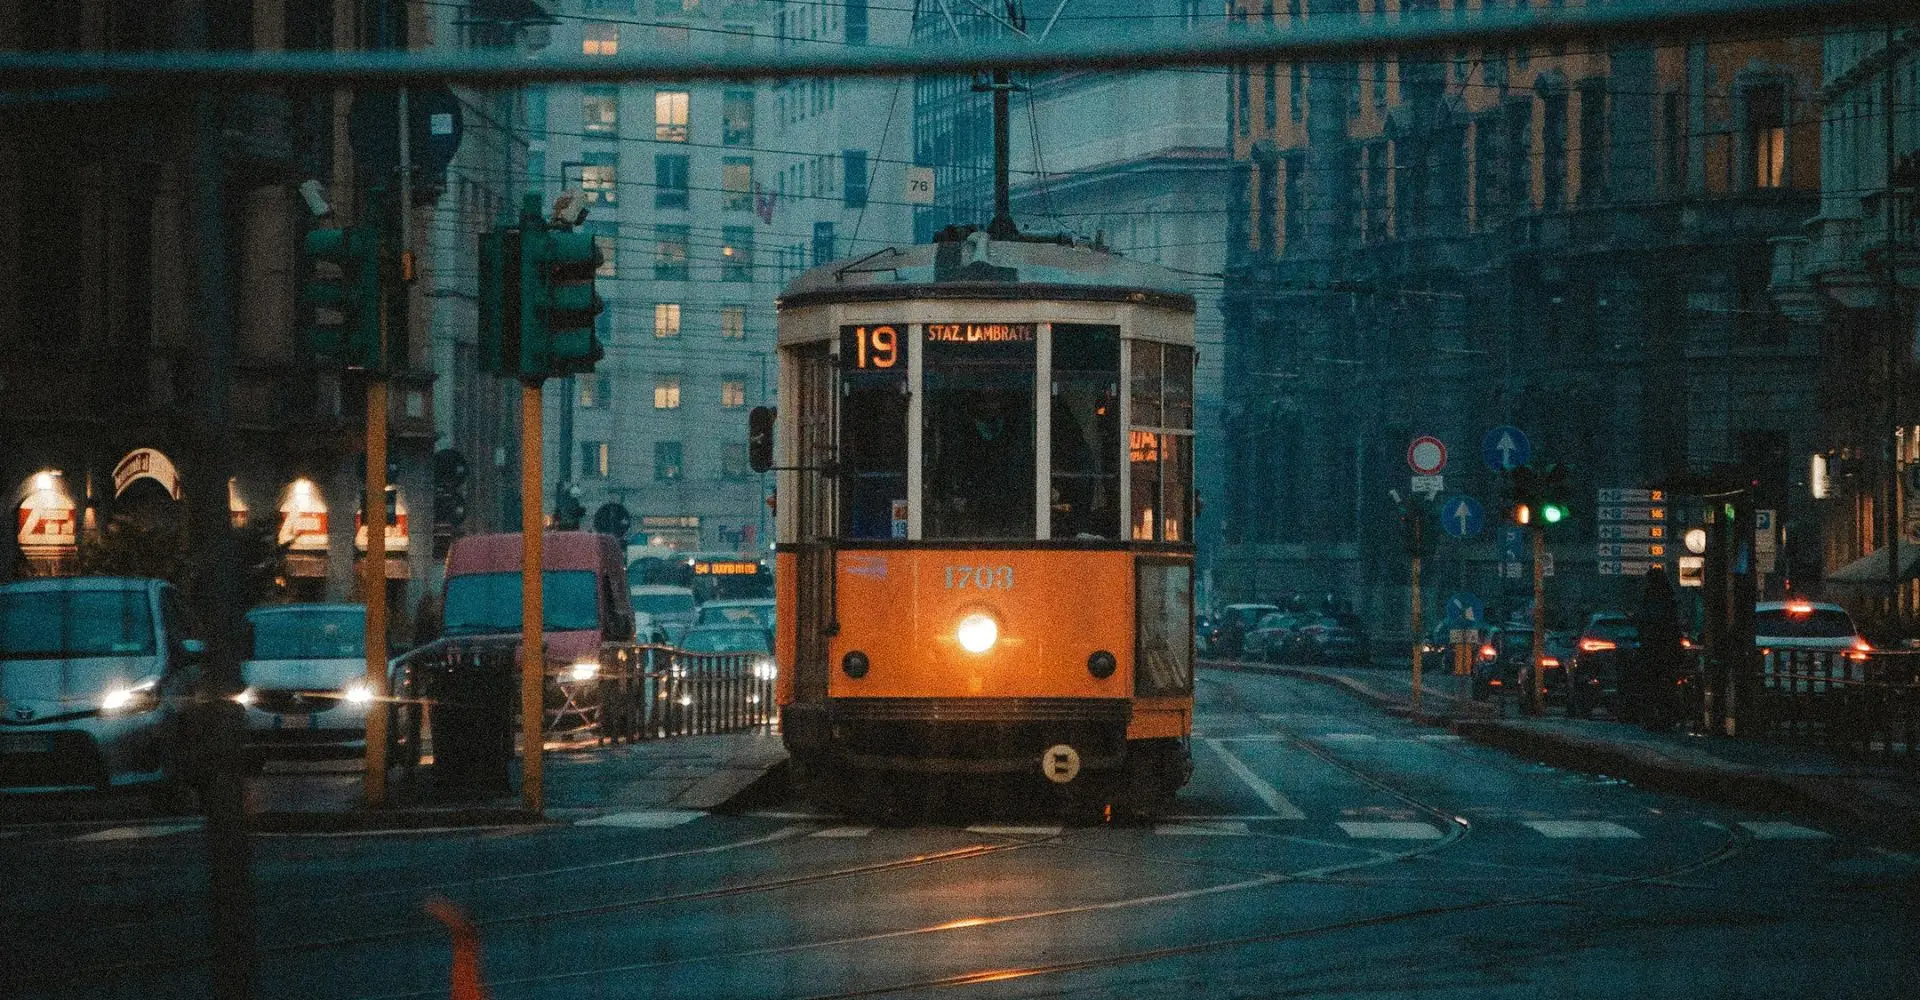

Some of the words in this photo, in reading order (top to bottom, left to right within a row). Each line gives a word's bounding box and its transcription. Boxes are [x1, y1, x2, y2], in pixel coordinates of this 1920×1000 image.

[911, 180, 928, 191] 76
[928, 324, 964, 341] STAZ.
[967, 324, 1033, 342] LAMBRATE
[855, 325, 897, 369] 19
[1652, 490, 1662, 500] 22
[945, 564, 1014, 591] 1703
